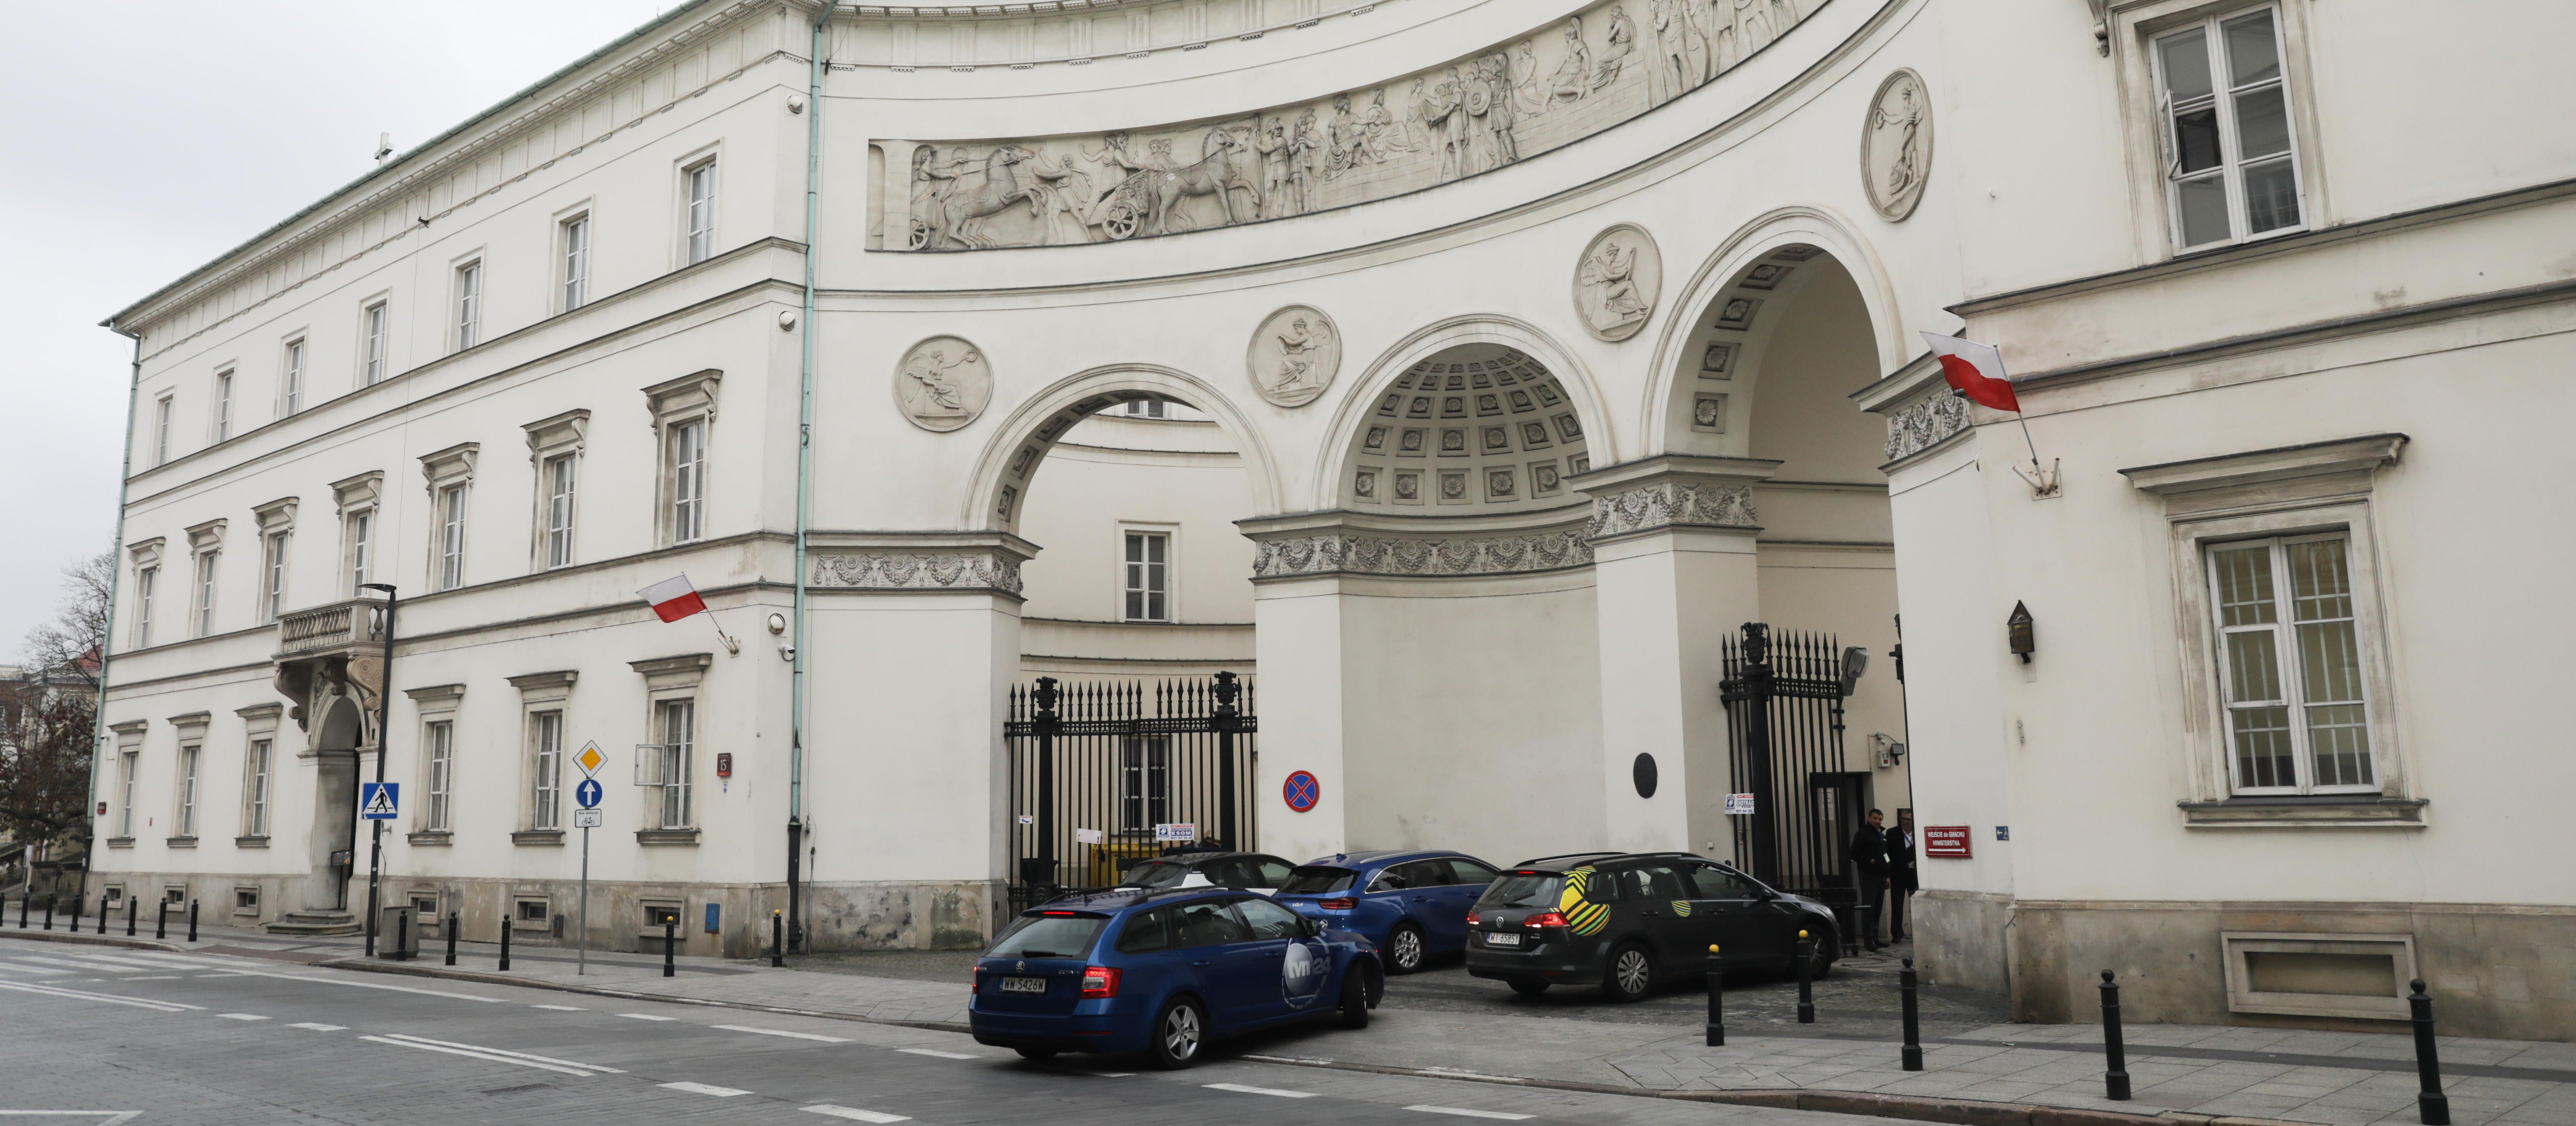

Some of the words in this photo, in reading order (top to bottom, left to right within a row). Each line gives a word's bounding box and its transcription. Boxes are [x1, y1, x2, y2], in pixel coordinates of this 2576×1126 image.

[720, 759, 726, 771] 15
[1500, 934, 1519, 943] 6585Y
[1005, 978, 1015, 989] WW
[1018, 979, 1044, 991] 5426W
